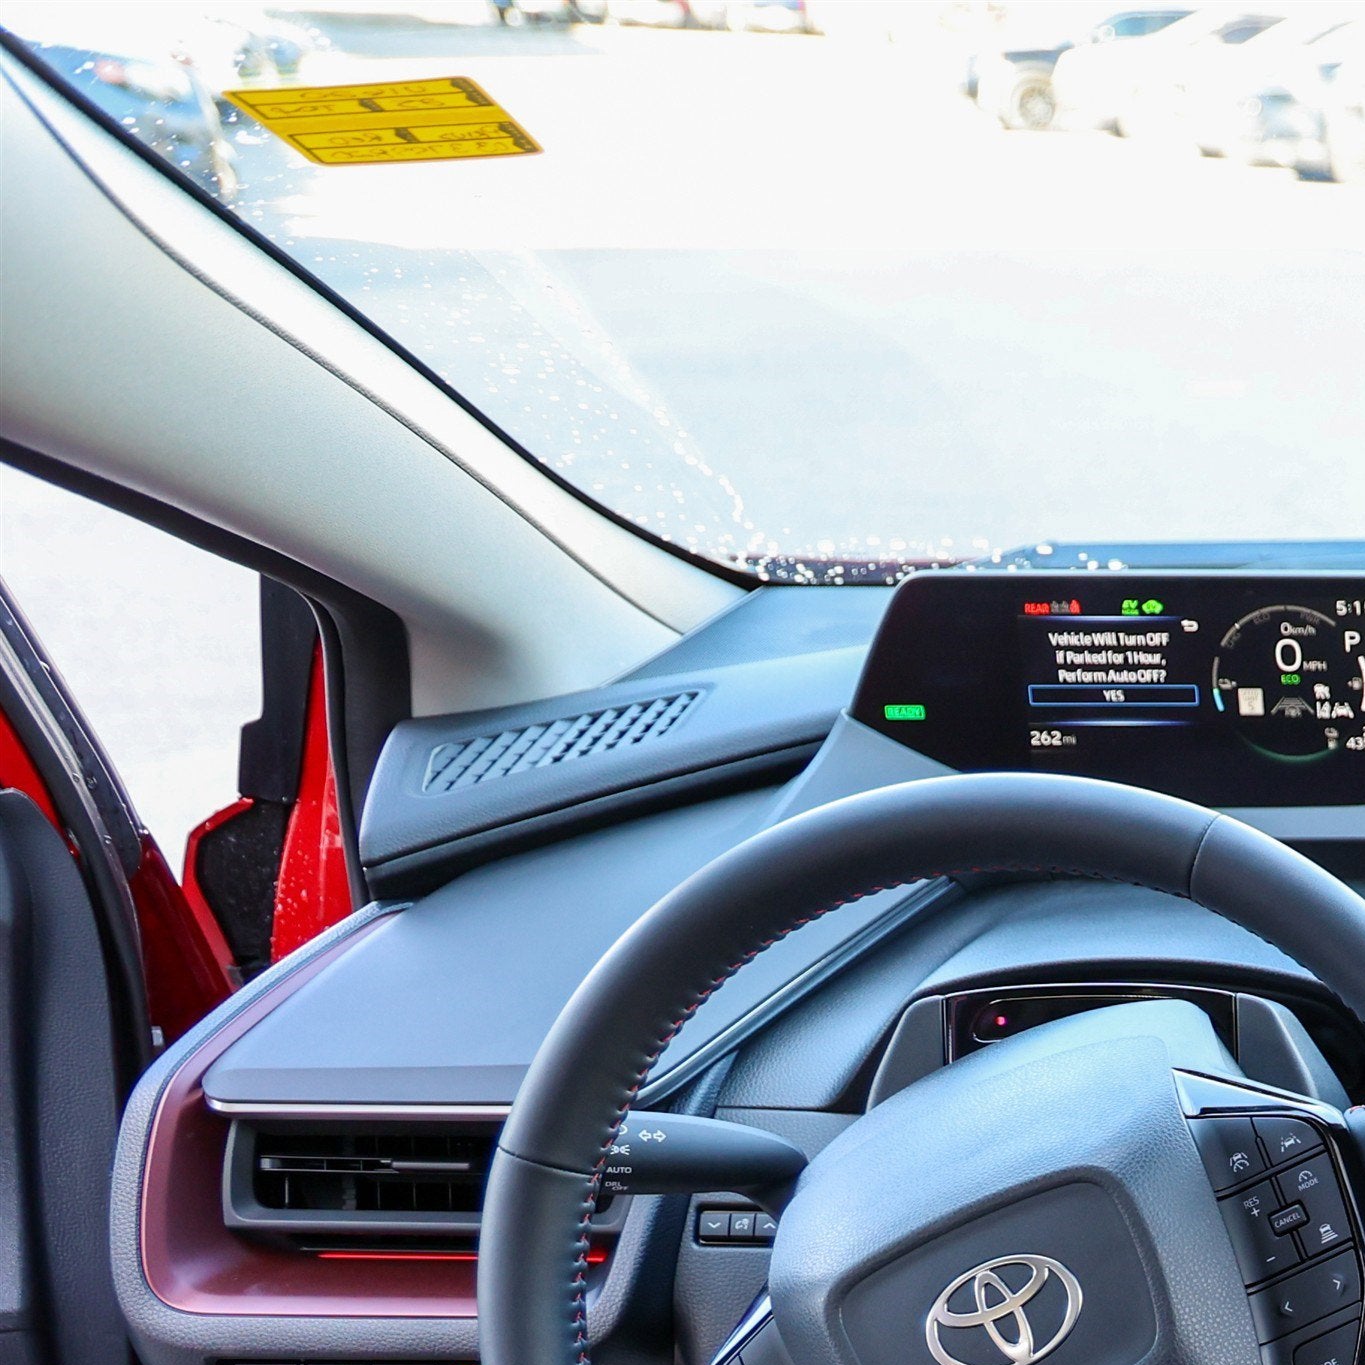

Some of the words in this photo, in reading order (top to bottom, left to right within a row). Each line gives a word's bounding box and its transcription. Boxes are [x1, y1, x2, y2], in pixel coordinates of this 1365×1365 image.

[1024, 602, 1050, 614] REAR
[1048, 632, 1092, 647] Vehicle
[1091, 632, 1119, 647] Will
[1118, 632, 1146, 647] Turn
[1146, 632, 1170, 647] OFF
[1343, 630, 1362, 653] P
[1055, 650, 1065, 665] if
[1066, 650, 1107, 665] Parked
[1107, 650, 1125, 665] for
[1132, 651, 1167, 667] Hour,
[1275, 637, 1302, 673] 0
[1302, 660, 1327, 672] MPH
[1058, 669, 1108, 683] Perform
[1108, 669, 1137, 683] Auto
[1137, 669, 1167, 683] OFF?
[1280, 674, 1301, 685] ECO
[1102, 689, 1125, 702] YES
[886, 706, 922, 718] READY
[606, 1166, 632, 1174] AUTO
[1297, 1175, 1319, 1192] MODE
[1243, 1195, 1261, 1210] RES
[1273, 1210, 1302, 1229] CANCEL
